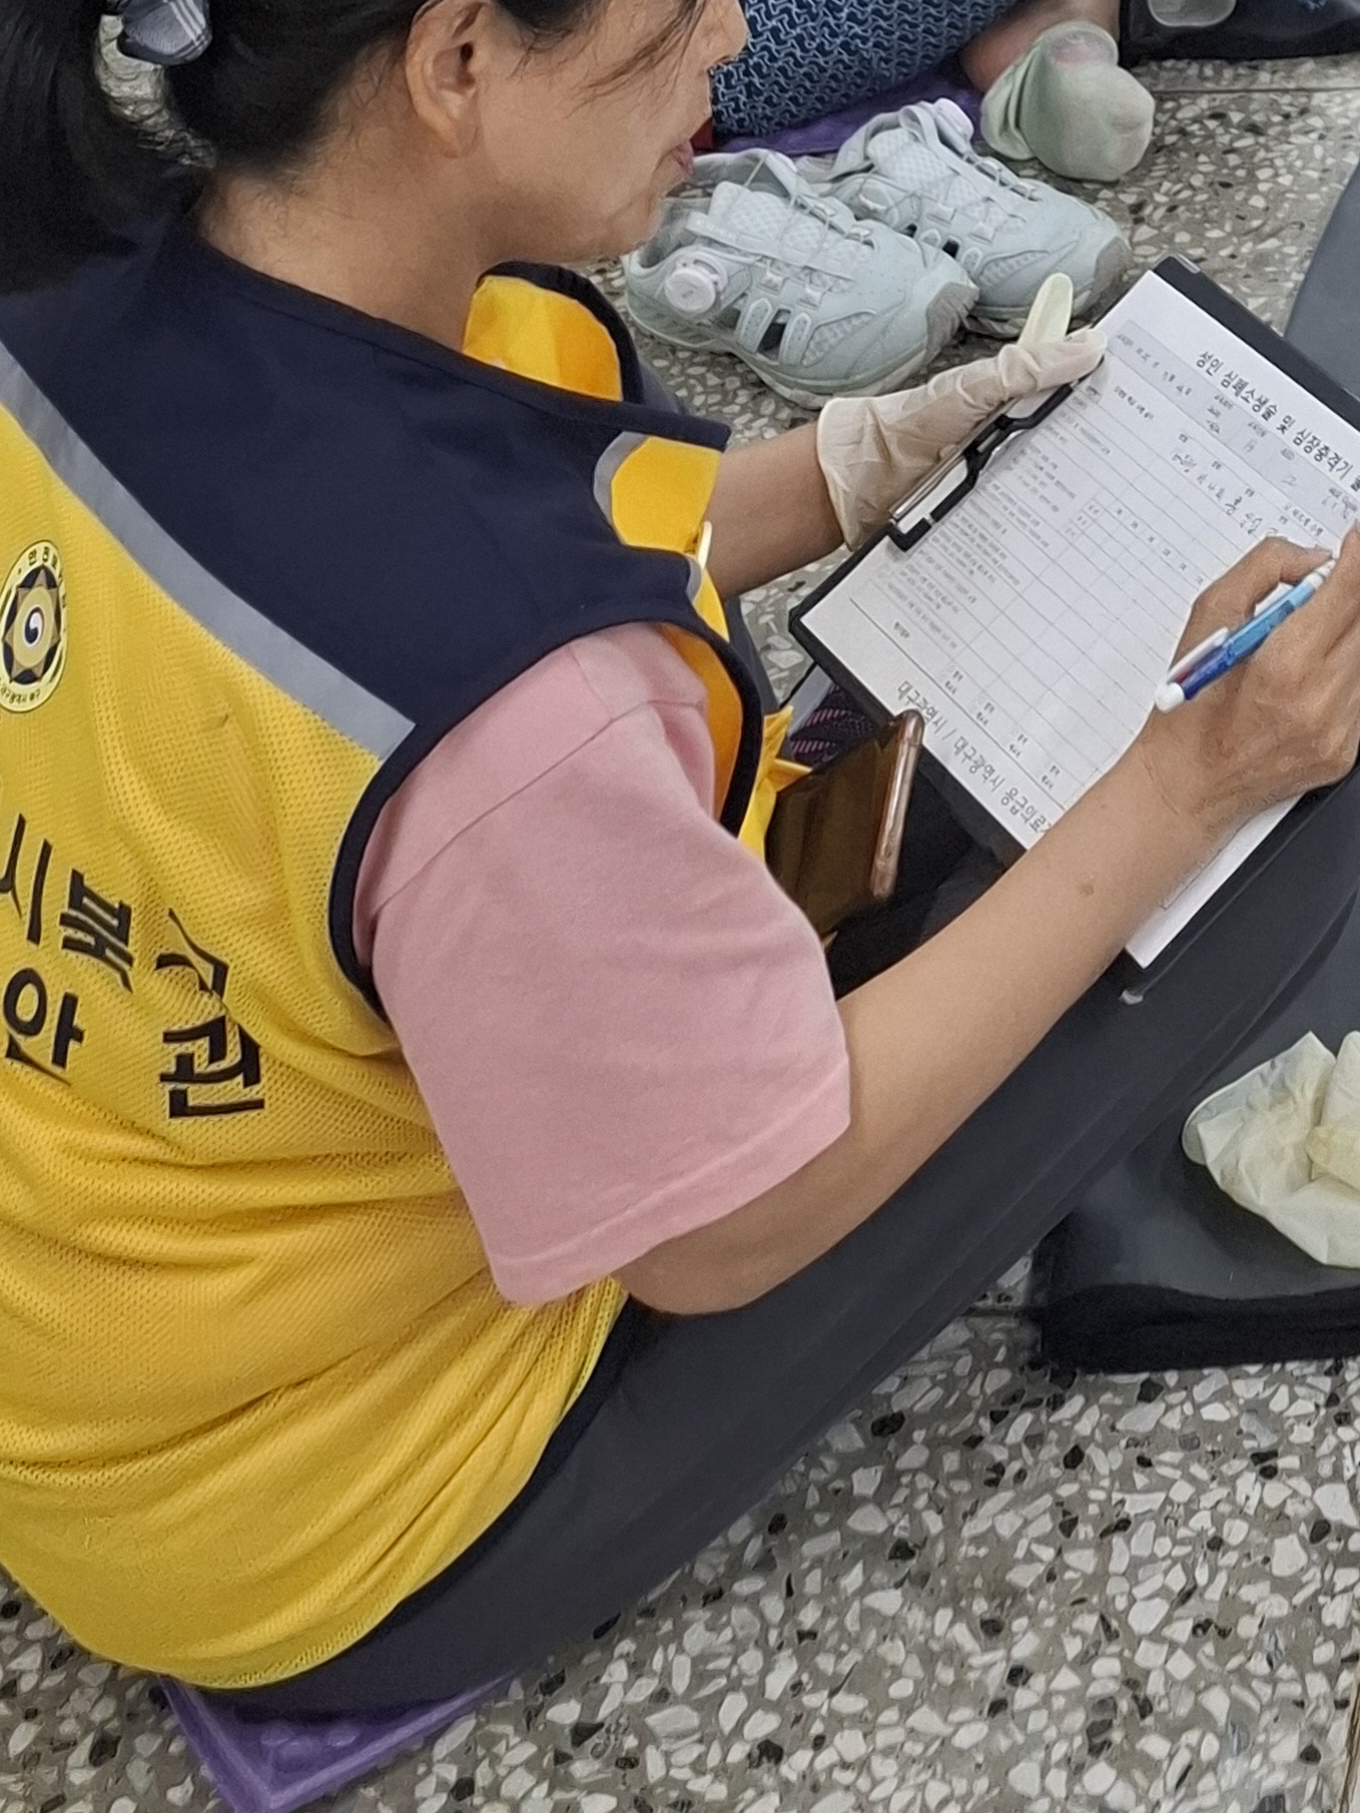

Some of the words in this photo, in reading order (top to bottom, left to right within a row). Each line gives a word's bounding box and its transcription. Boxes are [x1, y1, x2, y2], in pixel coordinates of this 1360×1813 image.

[1195, 350, 1224, 376] 성인
[1220, 370, 1278, 423] 심폐소생술
[1000, 786, 1053, 834] 응급의료
